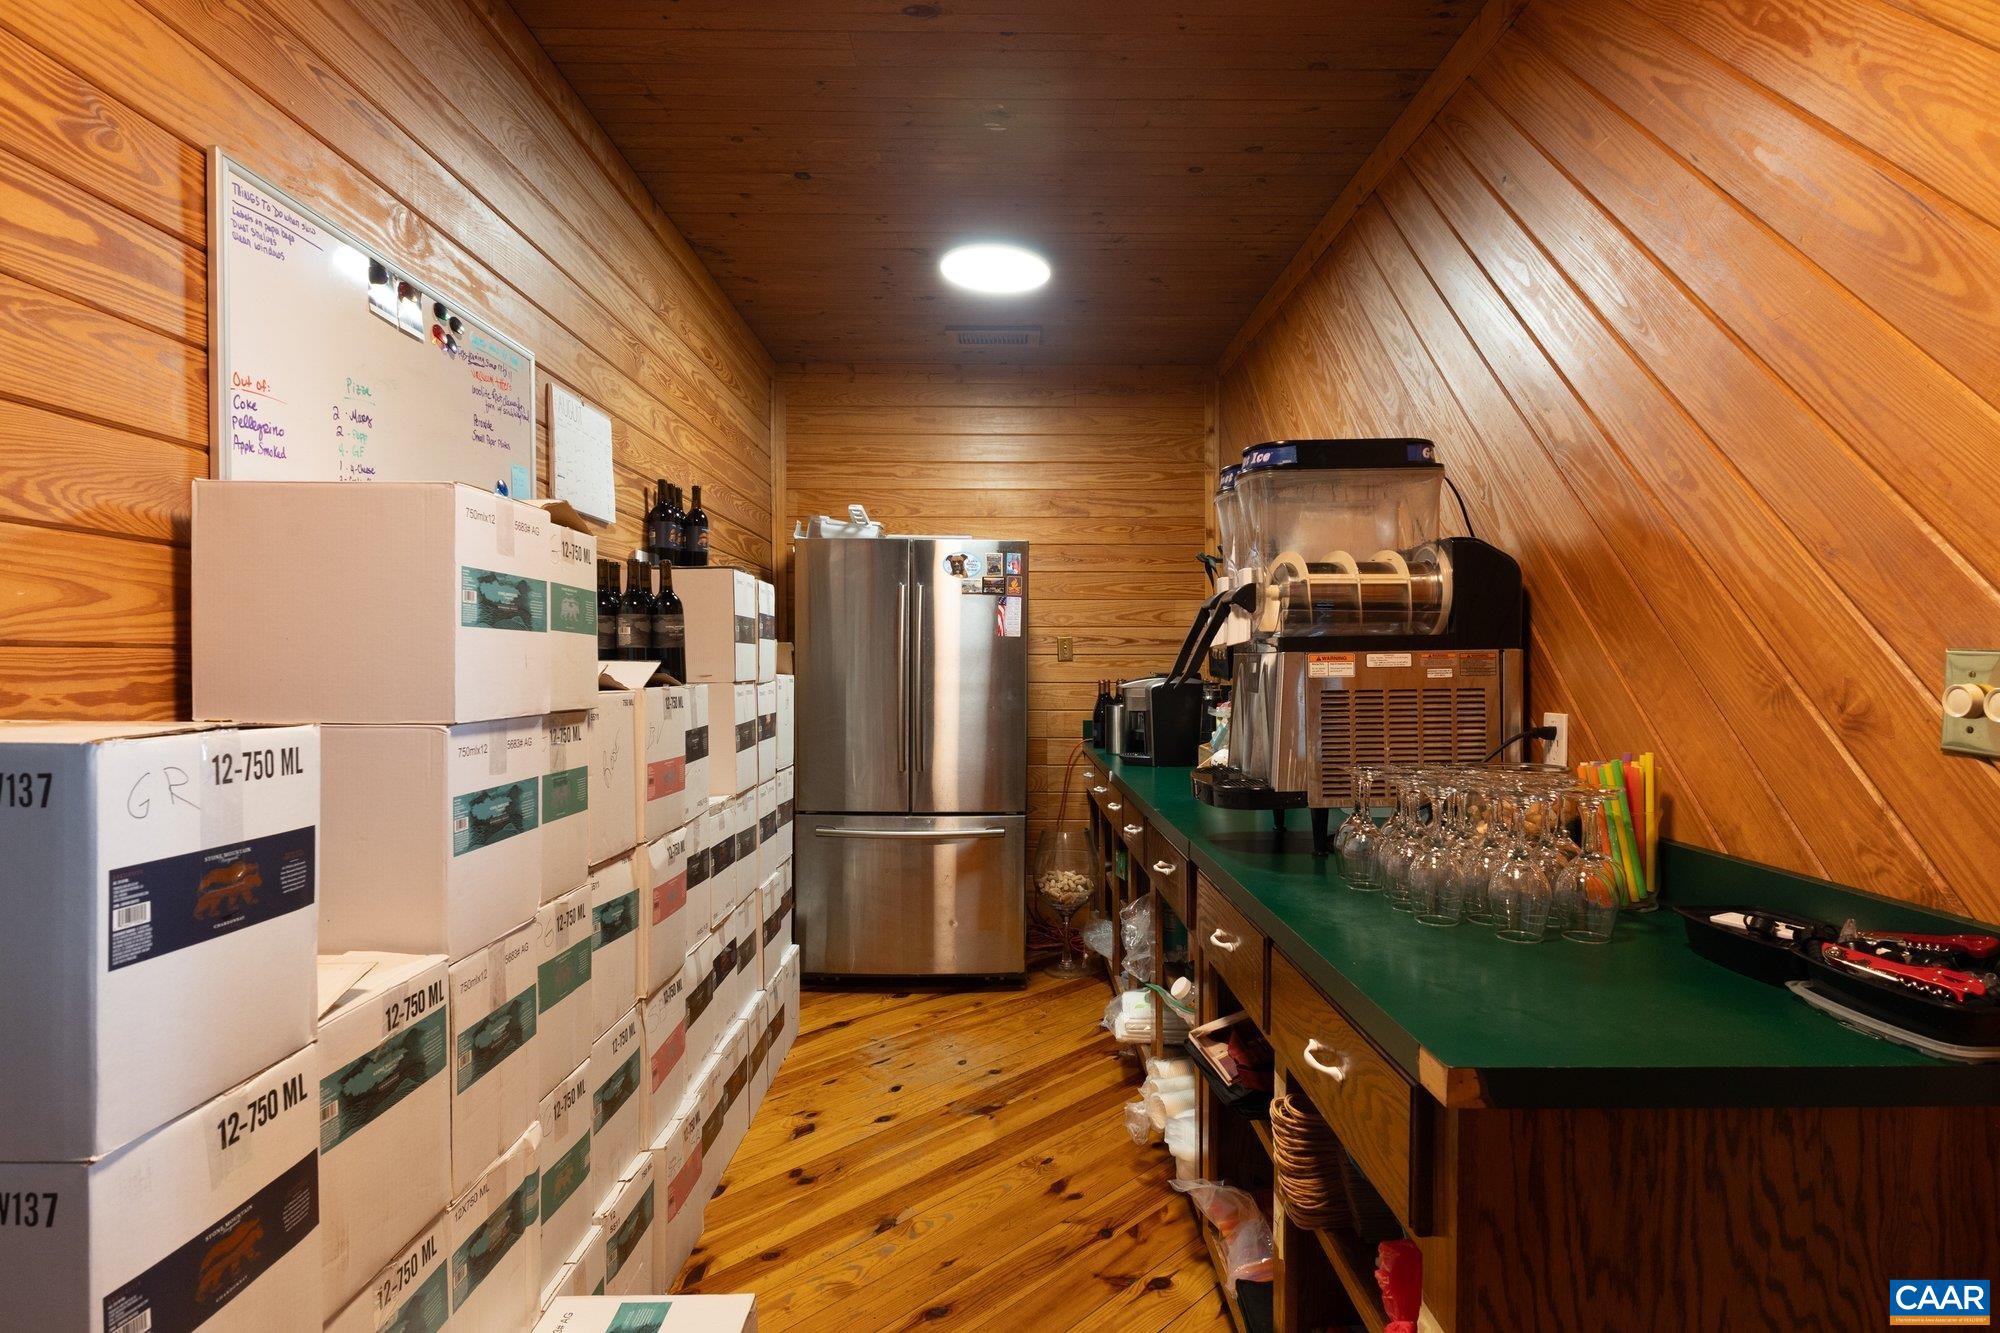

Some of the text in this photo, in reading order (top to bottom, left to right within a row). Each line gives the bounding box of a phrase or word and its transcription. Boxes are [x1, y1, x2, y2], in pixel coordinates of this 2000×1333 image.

[233, 371, 252, 387] Out
[346, 377, 372, 397] Pizza
[233, 394, 257, 411] Coke
[233, 433, 255, 455] Apple
[1250, 451, 1271, 465] Ice
[550, 726, 572, 747] 12-750
[211, 747, 303, 785] 12-750 ML
[556, 903, 586, 932] 12-750 ML
[385, 979, 445, 1032] 12-750 ML
[217, 1089, 278, 1150] 12-750
[283, 1073, 308, 1112] ML
[553, 1079, 586, 1119] 12-750 ML
[377, 1235, 438, 1310] 12-750 ML
